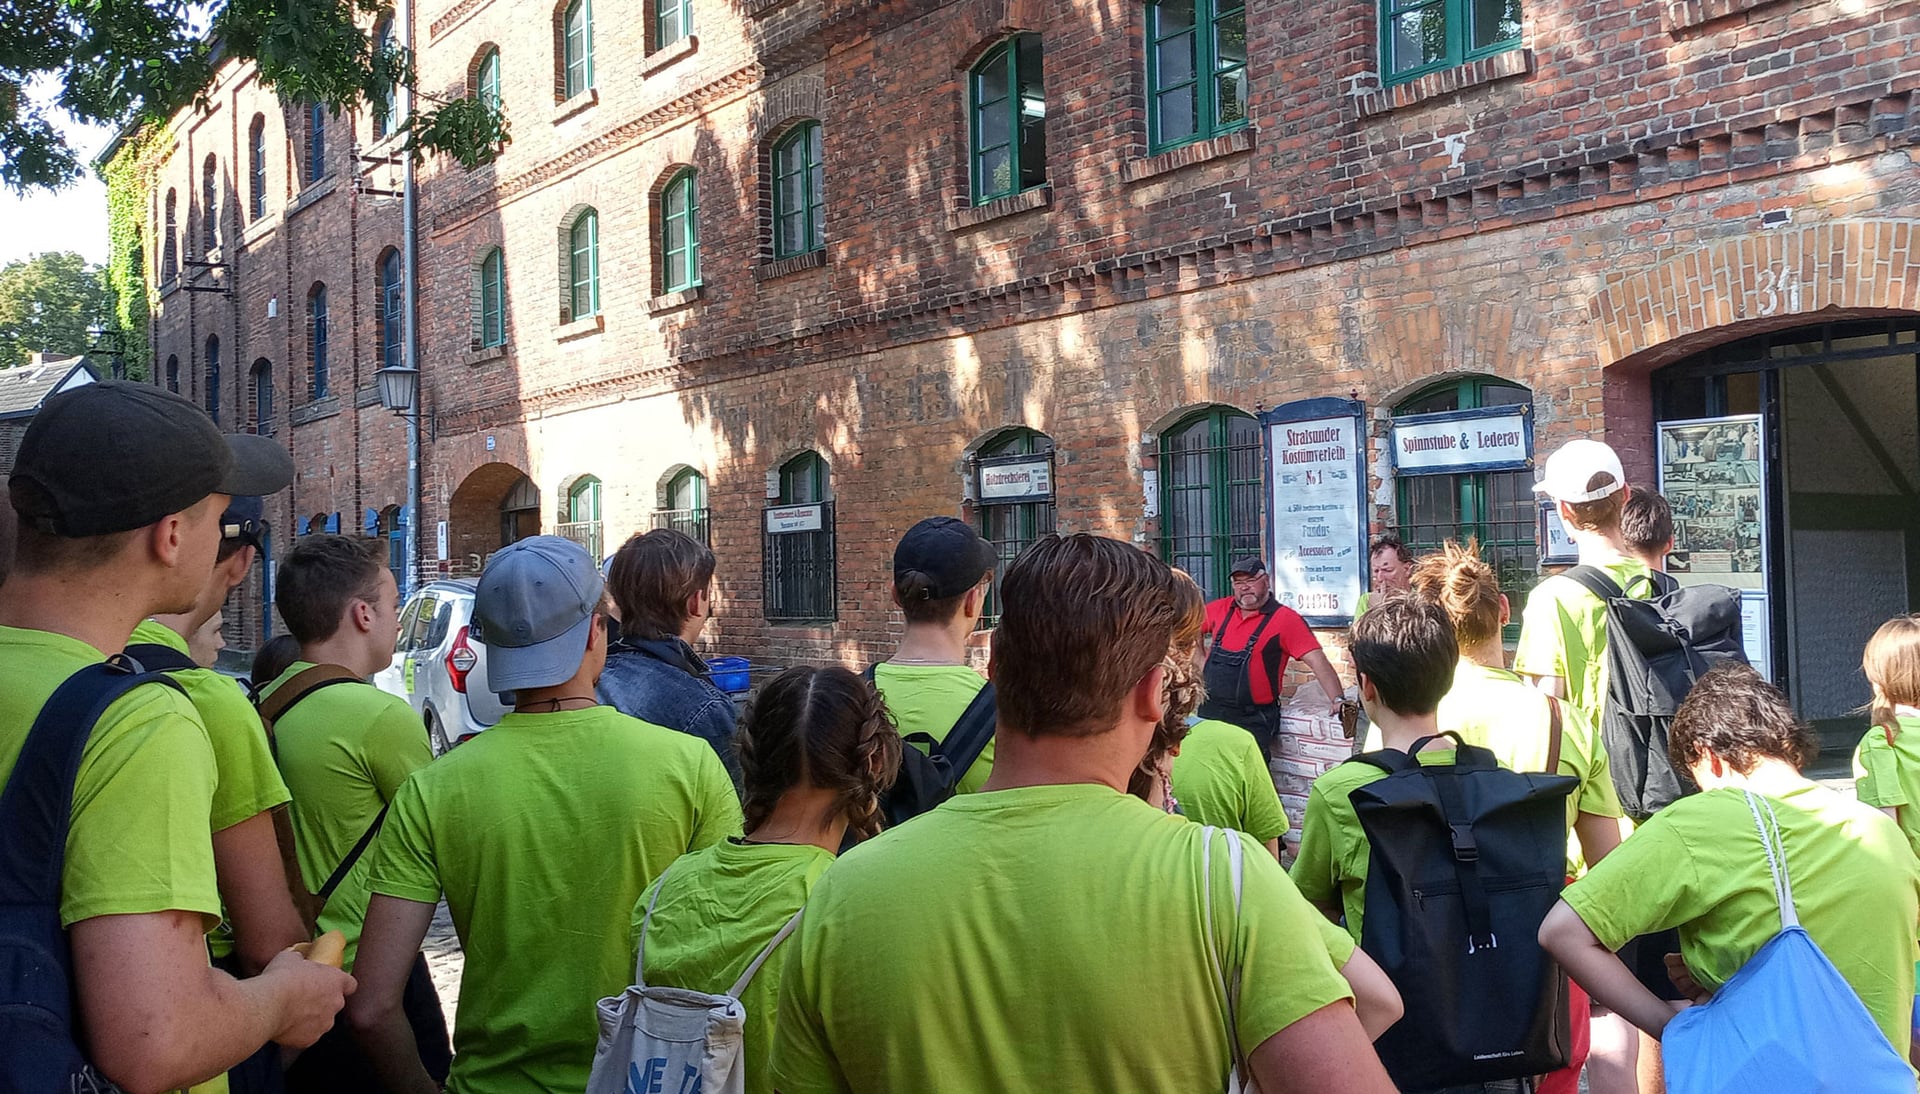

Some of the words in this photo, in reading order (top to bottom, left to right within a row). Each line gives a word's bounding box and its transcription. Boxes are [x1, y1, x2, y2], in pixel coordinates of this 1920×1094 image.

[1287, 426, 1341, 447] Stralsunder
[1402, 433, 1457, 454] Spinnstube
[1459, 432, 1470, 450] &
[1476, 430, 1520, 449] Lederay
[1282, 445, 1346, 465] Kostümverleih
[1298, 545, 1335, 557] Accessoires
